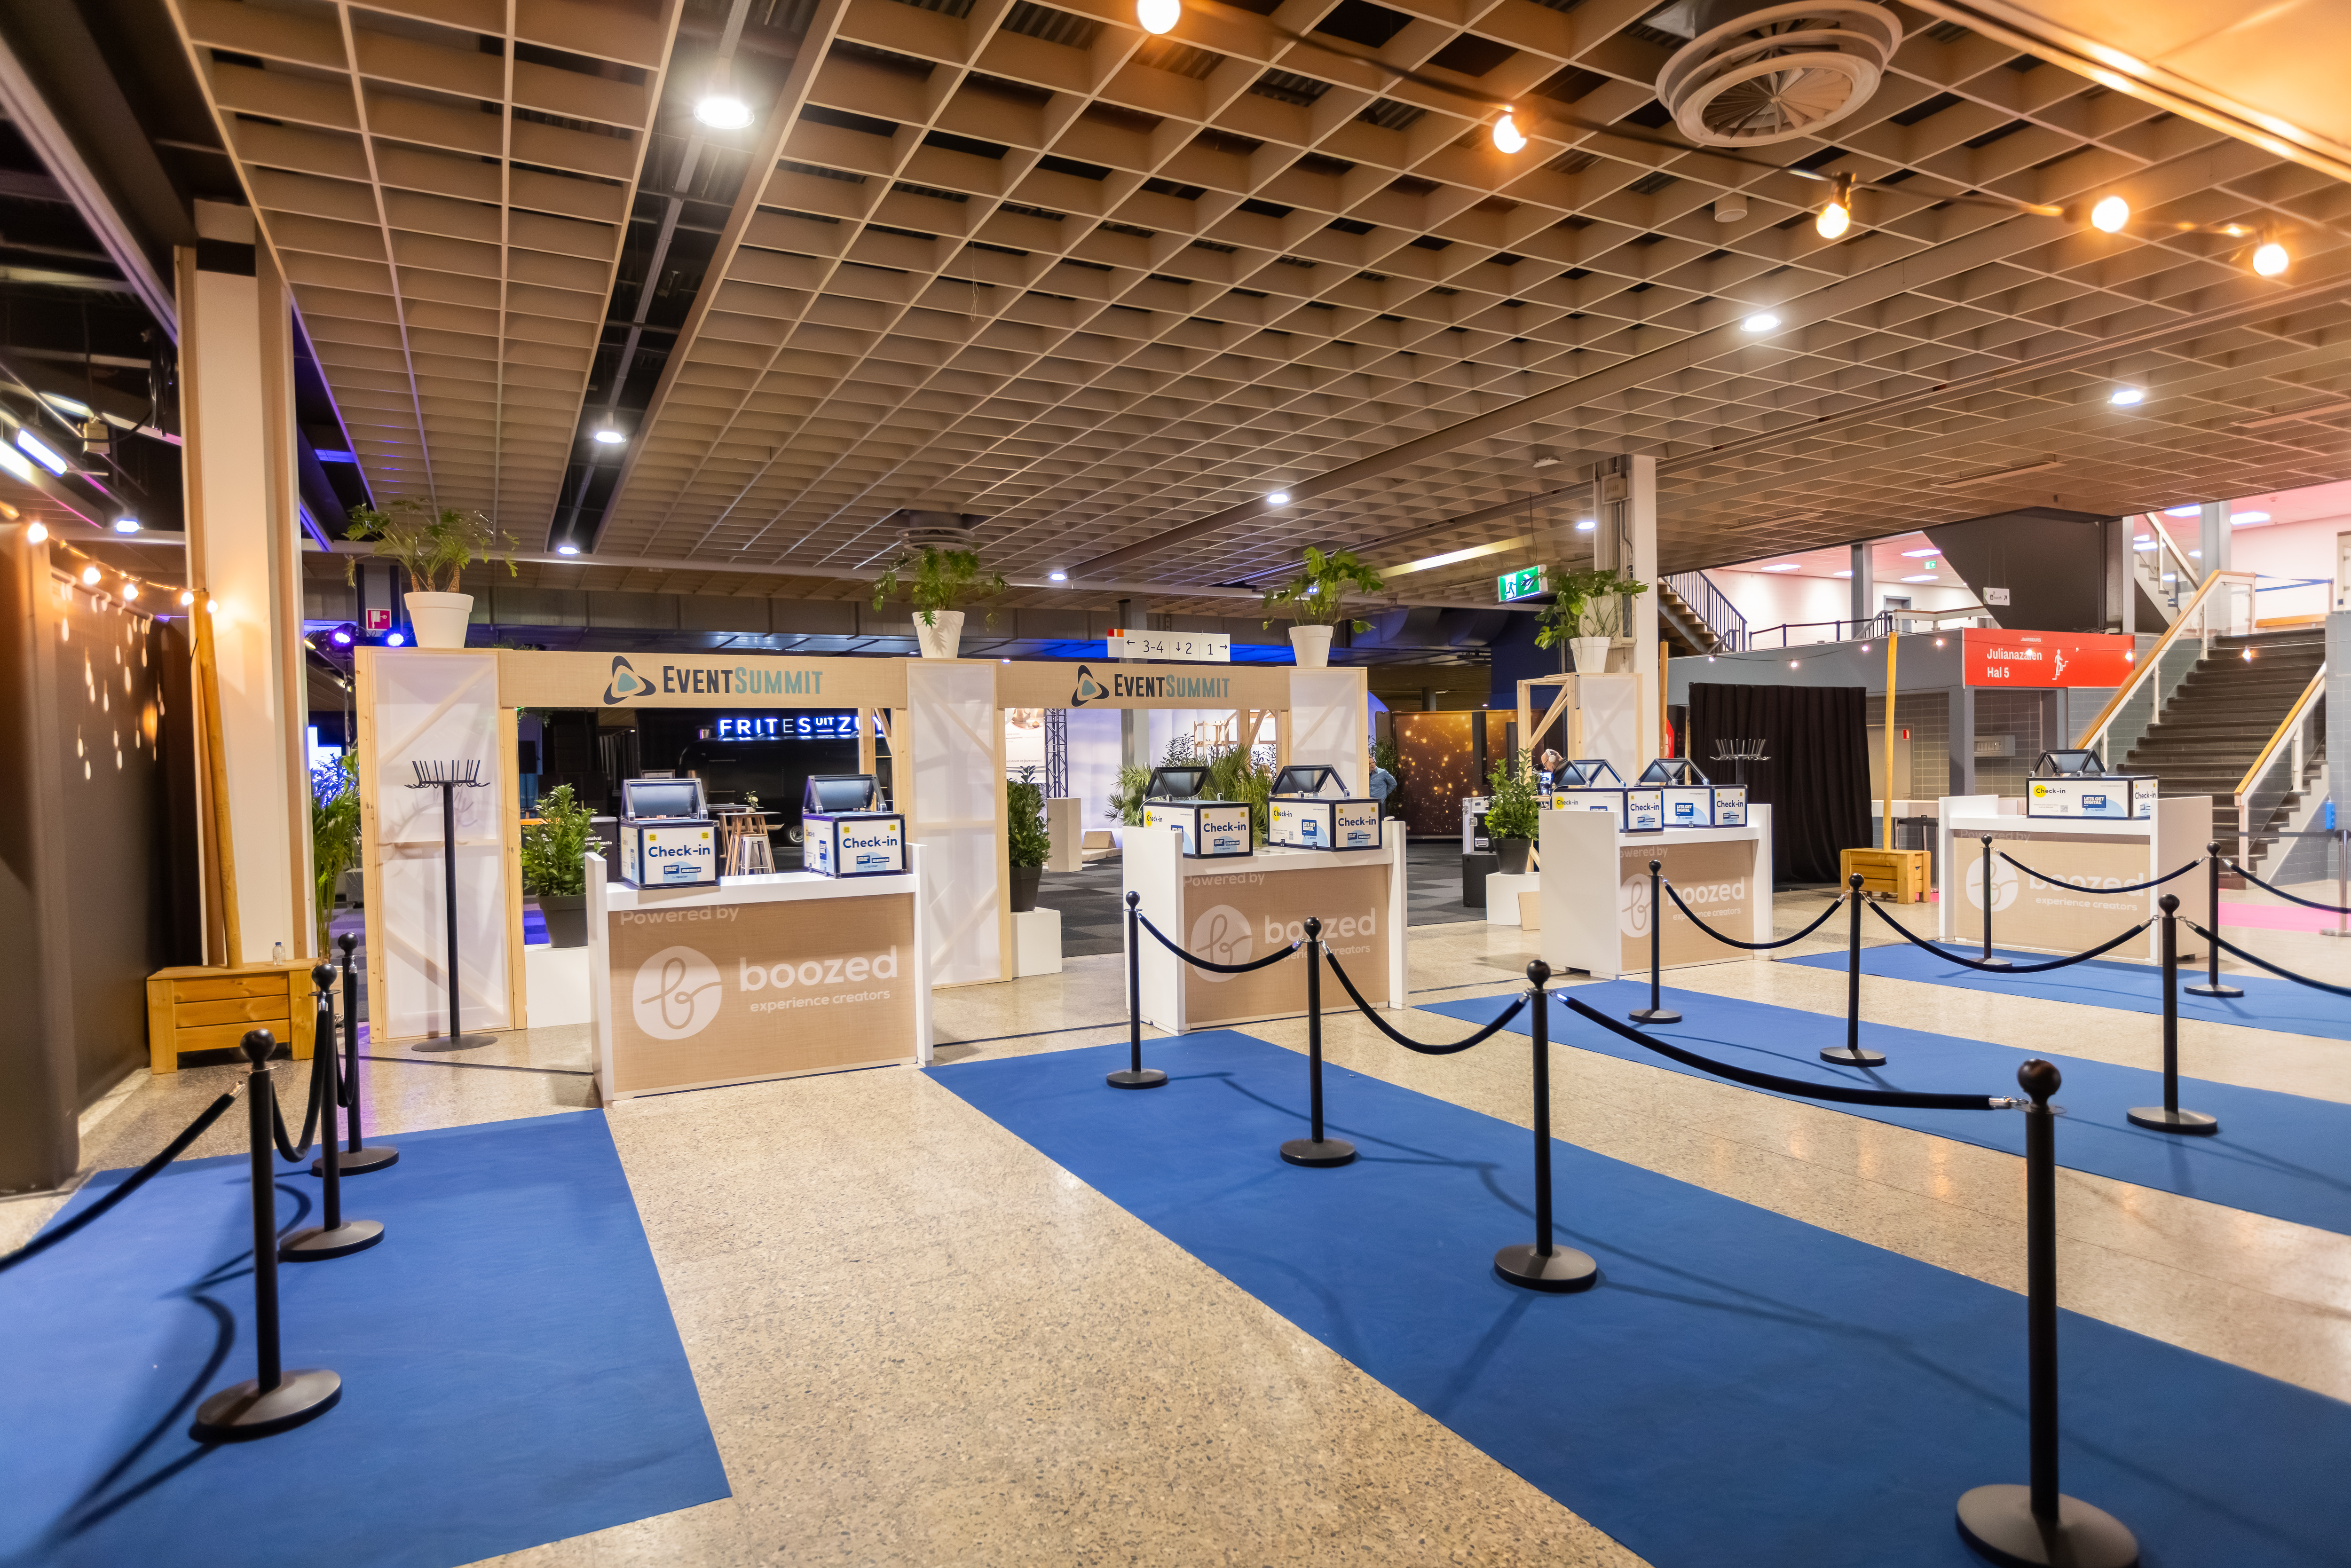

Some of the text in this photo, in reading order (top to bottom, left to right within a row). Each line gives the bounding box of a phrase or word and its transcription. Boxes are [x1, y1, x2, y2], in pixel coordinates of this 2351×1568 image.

[1143, 640, 1164, 653] 3-4
[1186, 642, 1192, 654] 2
[1207, 644, 1213, 655] 1
[1987, 667, 2009, 678] Hal 5
[720, 717, 811, 735] FRITES
[815, 717, 834, 726] UIT
[1630, 803, 1659, 811] Check-in
[1203, 821, 1246, 832] Check-in
[1338, 816, 1376, 827] Check-in
[843, 835, 898, 848] Check-in
[2016, 832, 2031, 843] by
[648, 844, 710, 857] Check-in
[1620, 846, 1668, 858] owered by
[1184, 873, 1265, 887] Powered by
[2029, 867, 2144, 897] boozed
[2035, 898, 2138, 911] experience creators
[621, 905, 739, 925] Powered by
[1712, 907, 1741, 916] creators
[1264, 907, 1376, 944] bozed
[740, 945, 898, 992] boozed
[750, 990, 891, 1013] experience creators
